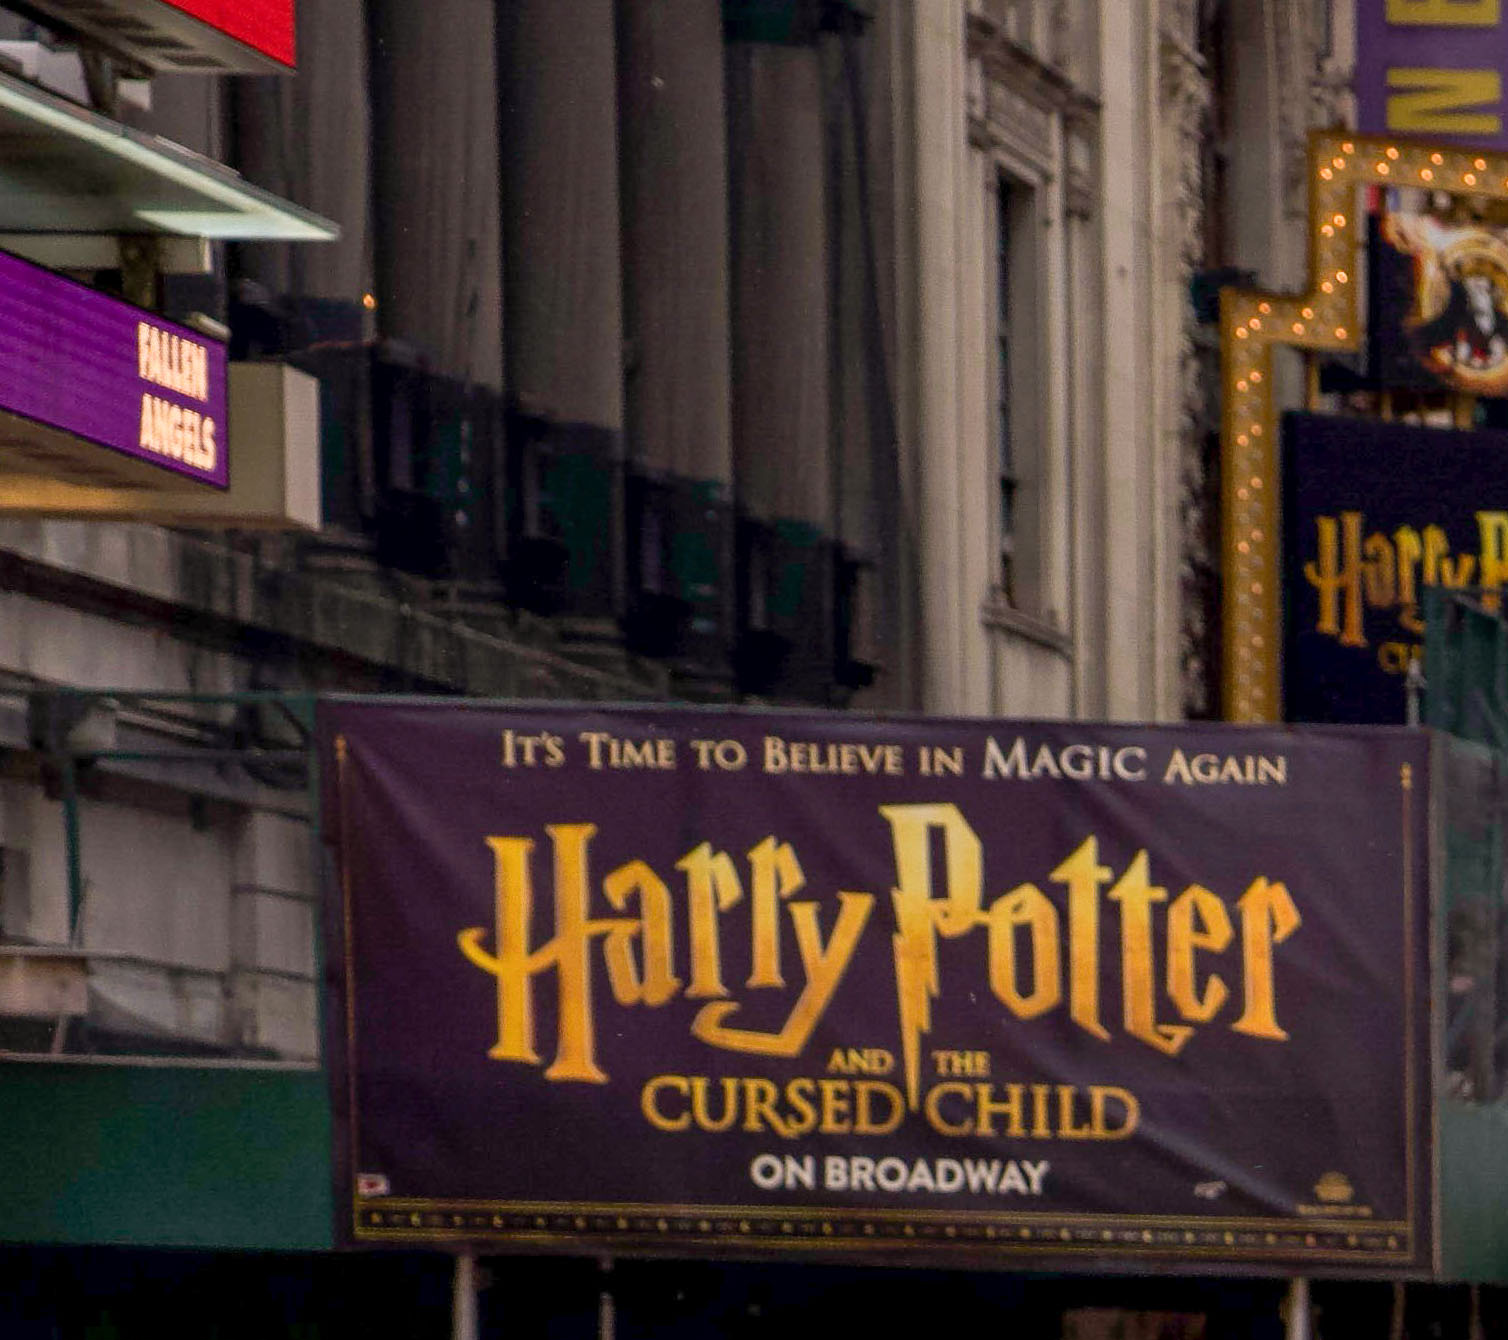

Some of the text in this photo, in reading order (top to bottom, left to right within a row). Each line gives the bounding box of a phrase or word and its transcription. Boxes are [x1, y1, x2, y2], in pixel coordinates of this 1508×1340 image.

[138, 321, 208, 403] FALLEN
[139, 393, 217, 472] ANGELS
[458, 822, 875, 1084] Harry
[878, 802, 1303, 1110] Potter
[826, 1048, 992, 1077] AND THE
[639, 1074, 1142, 1140] CURSED CHILD
[749, 1153, 1051, 1194] ON BROADWAY
